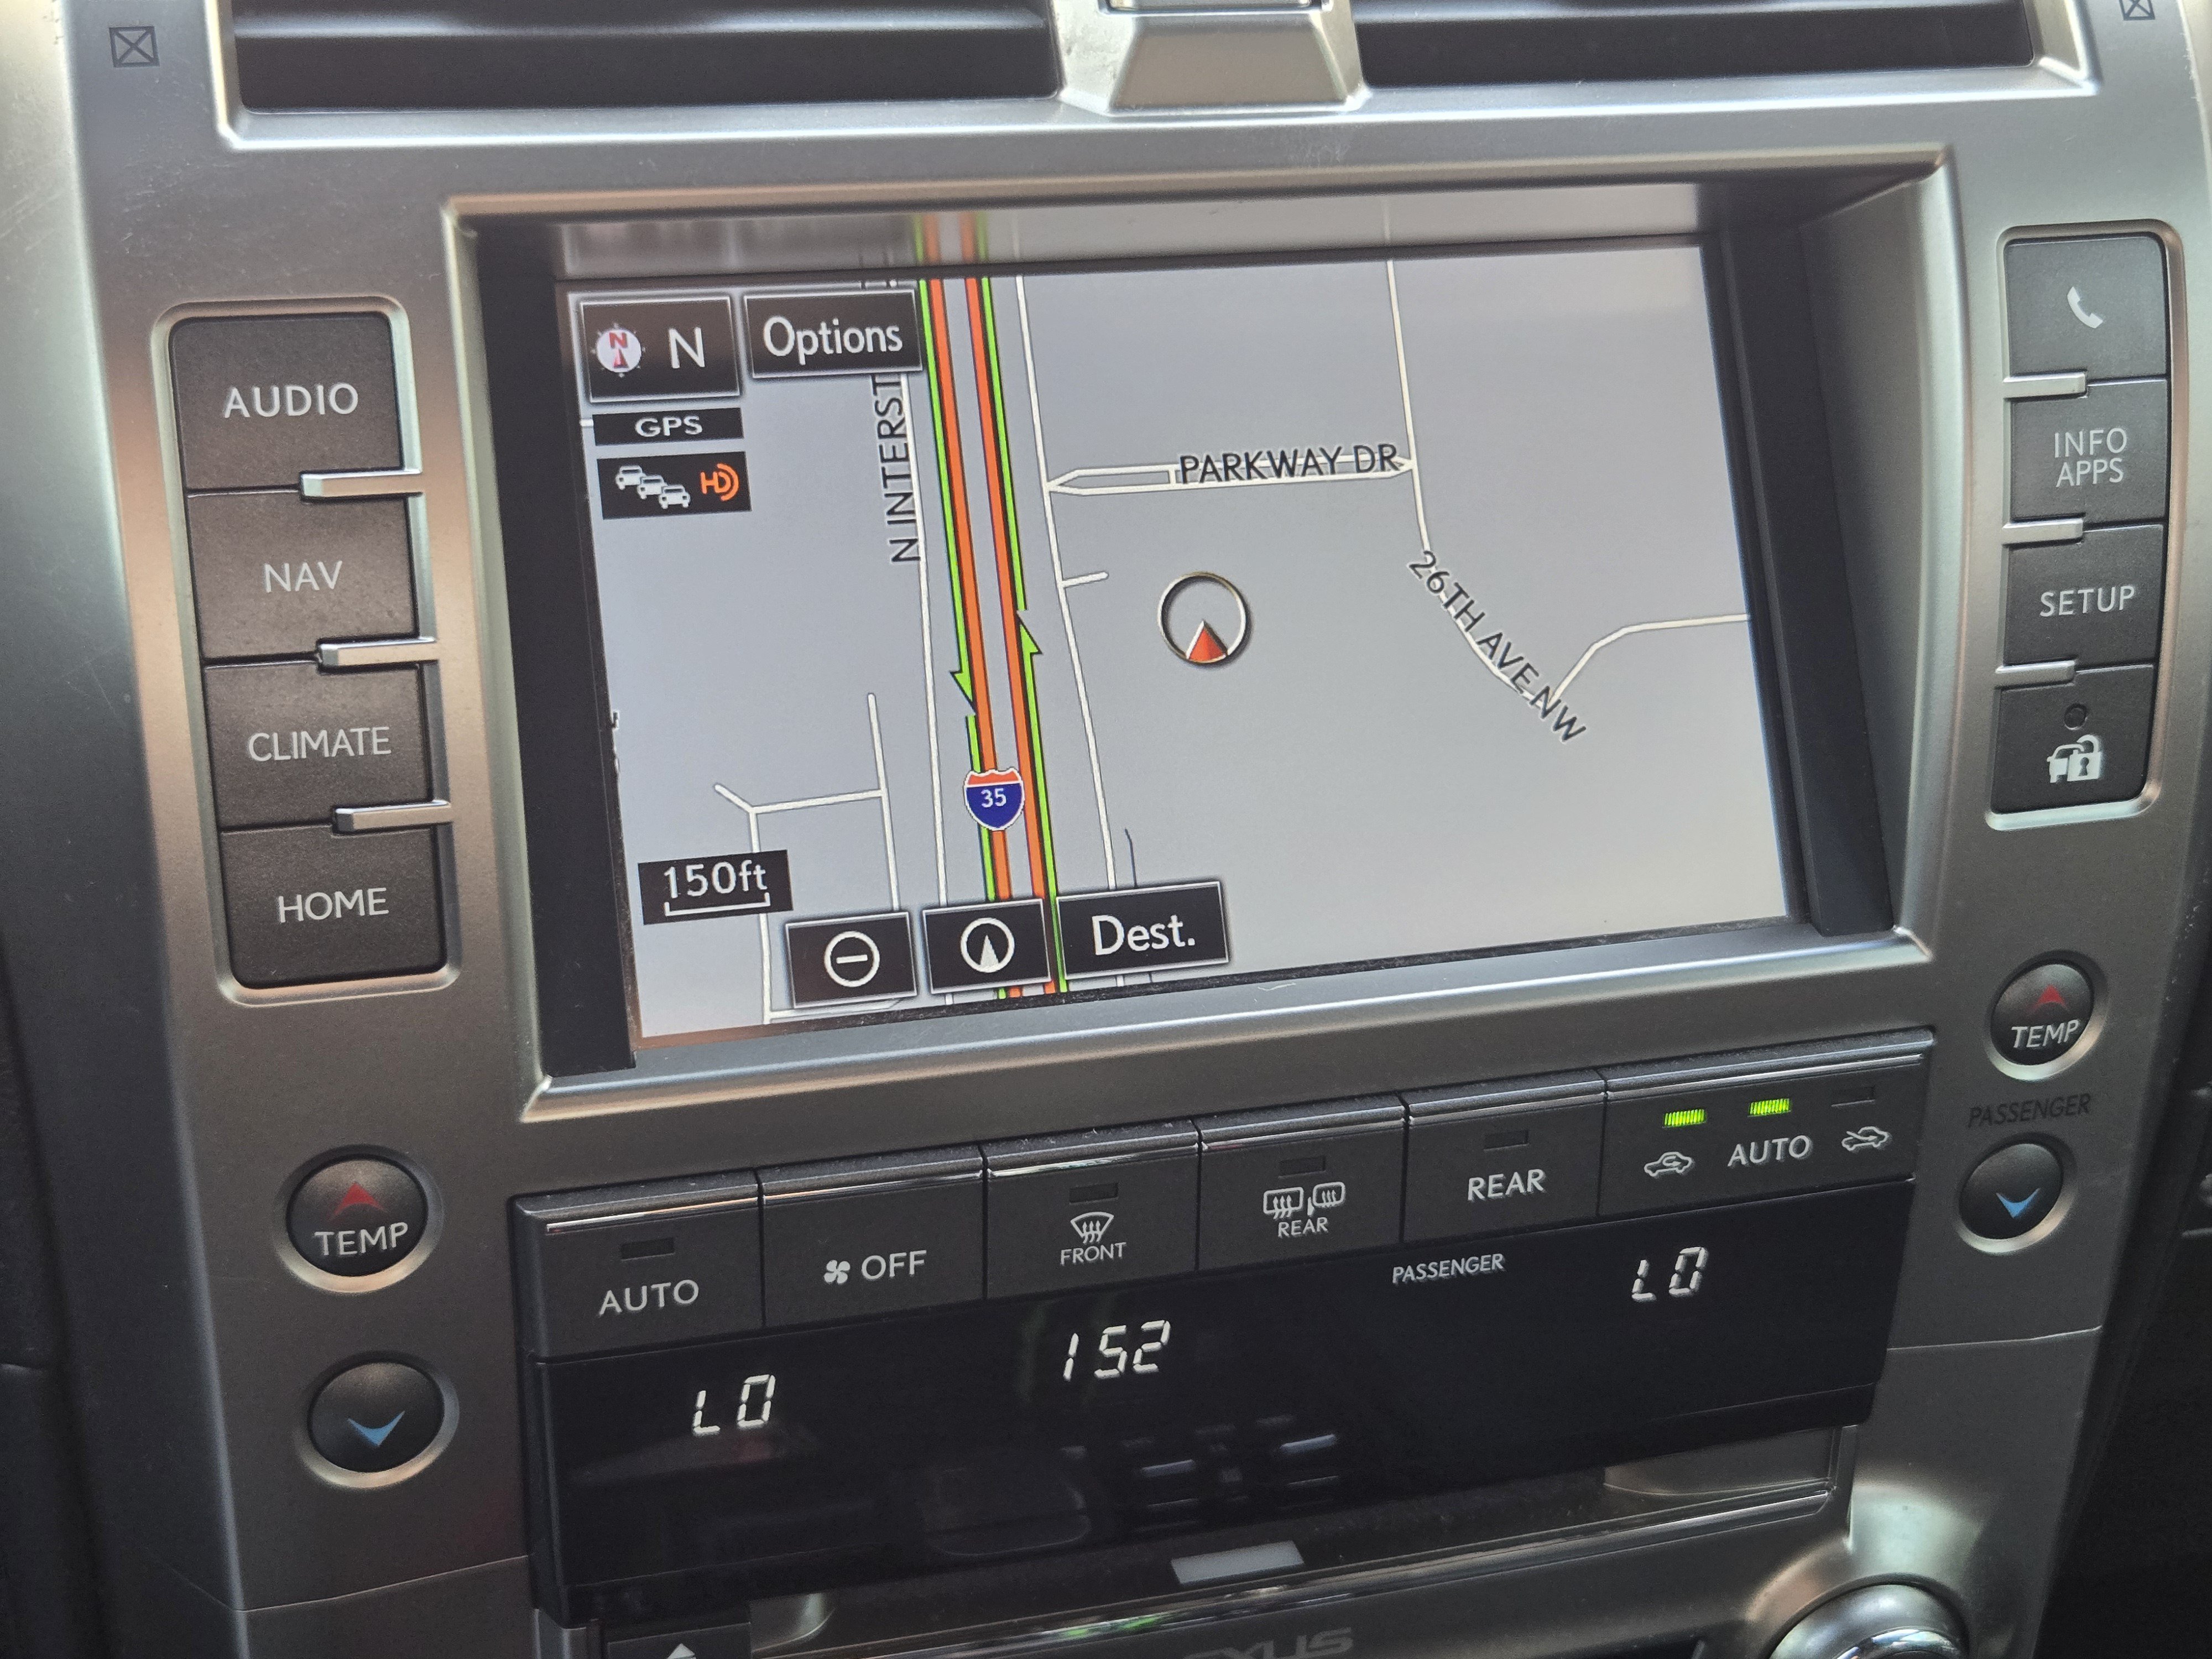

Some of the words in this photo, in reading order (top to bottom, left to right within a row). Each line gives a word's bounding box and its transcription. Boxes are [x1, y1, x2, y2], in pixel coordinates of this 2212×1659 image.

[608, 332, 628, 348] N
[668, 326, 706, 369] N
[763, 315, 904, 366] Options
[224, 382, 359, 418] AUDIO
[635, 416, 703, 437] GPS
[2054, 427, 2127, 458] INFO
[870, 374, 917, 525] INTERST
[1180, 446, 1343, 484] PARKWAY
[1353, 443, 1400, 473] DR
[2056, 457, 2125, 488] APPS
[889, 538, 921, 562] N
[263, 560, 343, 593] NAV
[2039, 585, 2135, 617] SETUP
[1408, 550, 1485, 632] 26TH
[1476, 632, 1540, 694] AVE
[1529, 685, 1587, 743] NW
[247, 726, 392, 762] CLIMATE
[980, 787, 1007, 808] 35
[664, 859, 768, 899] 150ft
[278, 887, 389, 923] HOME
[1091, 914, 1196, 956] Dest.
[2011, 1019, 2080, 1049] TEMP
[1968, 1092, 2091, 1128] PASSENGER
[1727, 1135, 1812, 1167] AUTO
[1467, 1168, 1546, 1202] REAR
[314, 1222, 409, 1256] TEMP
[1277, 1217, 1328, 1238] REAR
[860, 1249, 927, 1280] OFF
[1060, 1241, 1128, 1266] FRONT
[1392, 1253, 1505, 1285] PASSENGER
[598, 1279, 699, 1317] AUTO
[1063, 1319, 1171, 1381] 152
